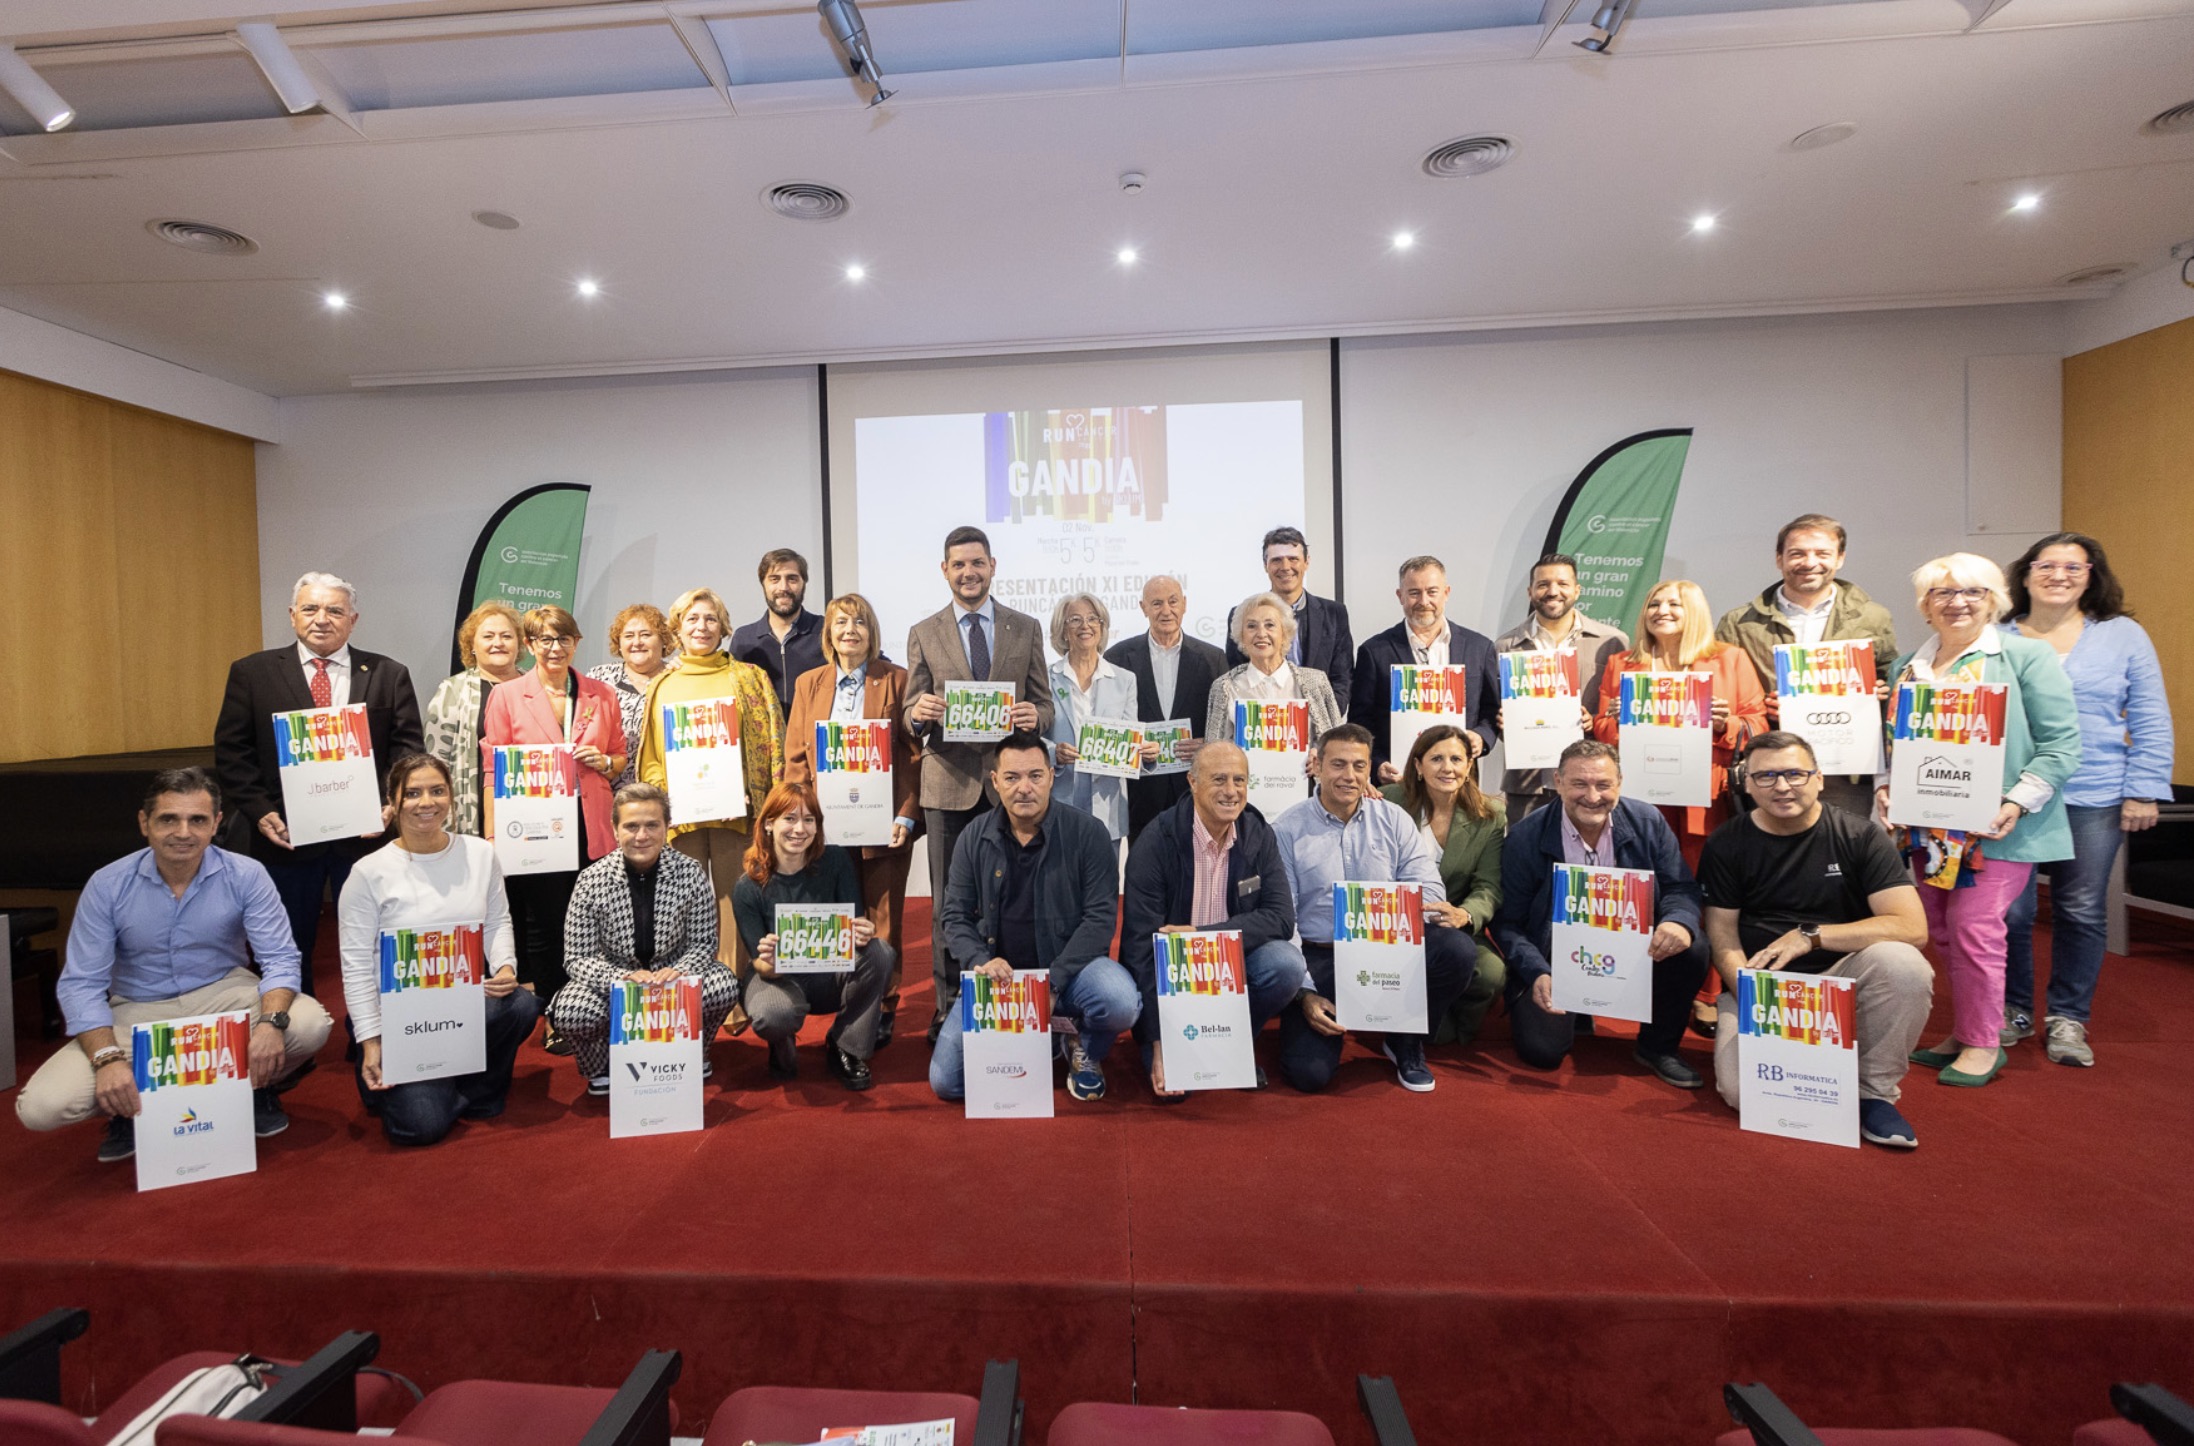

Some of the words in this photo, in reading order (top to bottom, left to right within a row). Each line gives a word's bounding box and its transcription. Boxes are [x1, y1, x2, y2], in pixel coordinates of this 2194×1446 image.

[1043, 427, 1075, 443] RUN
[1008, 456, 1139, 498] GANDIA
[1575, 553, 1645, 568] Tenemos
[990, 572, 1096, 597] RESENTACIÓN
[1102, 575, 1118, 592] XI
[1594, 571, 1629, 584] gran
[499, 582, 563, 600] Tenemos
[1580, 585, 1625, 598] amino
[518, 600, 548, 612] gra
[1509, 672, 1567, 690] GANDIA
[1787, 667, 1861, 687] GANDIA
[1400, 688, 1454, 703] GANDIA
[949, 704, 1011, 725] 66406
[1630, 699, 1698, 716] GANDIA
[1907, 712, 1988, 731] GANDIA
[672, 722, 728, 742] GANDIA
[1243, 724, 1298, 741] GANDIA
[287, 731, 357, 755] GANDIA
[1082, 737, 1141, 763] 66407
[825, 745, 880, 762] GANDIA
[504, 771, 565, 788] GANDIA
[1924, 768, 1972, 782] AIMAR
[1916, 788, 1971, 799] inmobiliaria
[1565, 895, 1638, 919] GANDIA
[1344, 912, 1411, 930] GANDIA
[781, 928, 851, 953] 66446
[393, 954, 469, 979] GANDIA
[1167, 962, 1233, 982] GANDIA
[621, 1008, 688, 1032] GANDIA
[972, 1001, 1037, 1021] GANDIA
[1751, 1003, 1839, 1032] GANDIA
[404, 1019, 456, 1036] sklum
[147, 1046, 233, 1077] GANDIA
[650, 1062, 687, 1074] VICKY
[653, 1073, 683, 1082] FOODS
[1757, 1062, 1784, 1081] RB
[633, 1086, 677, 1096] FUNDACIÓN
